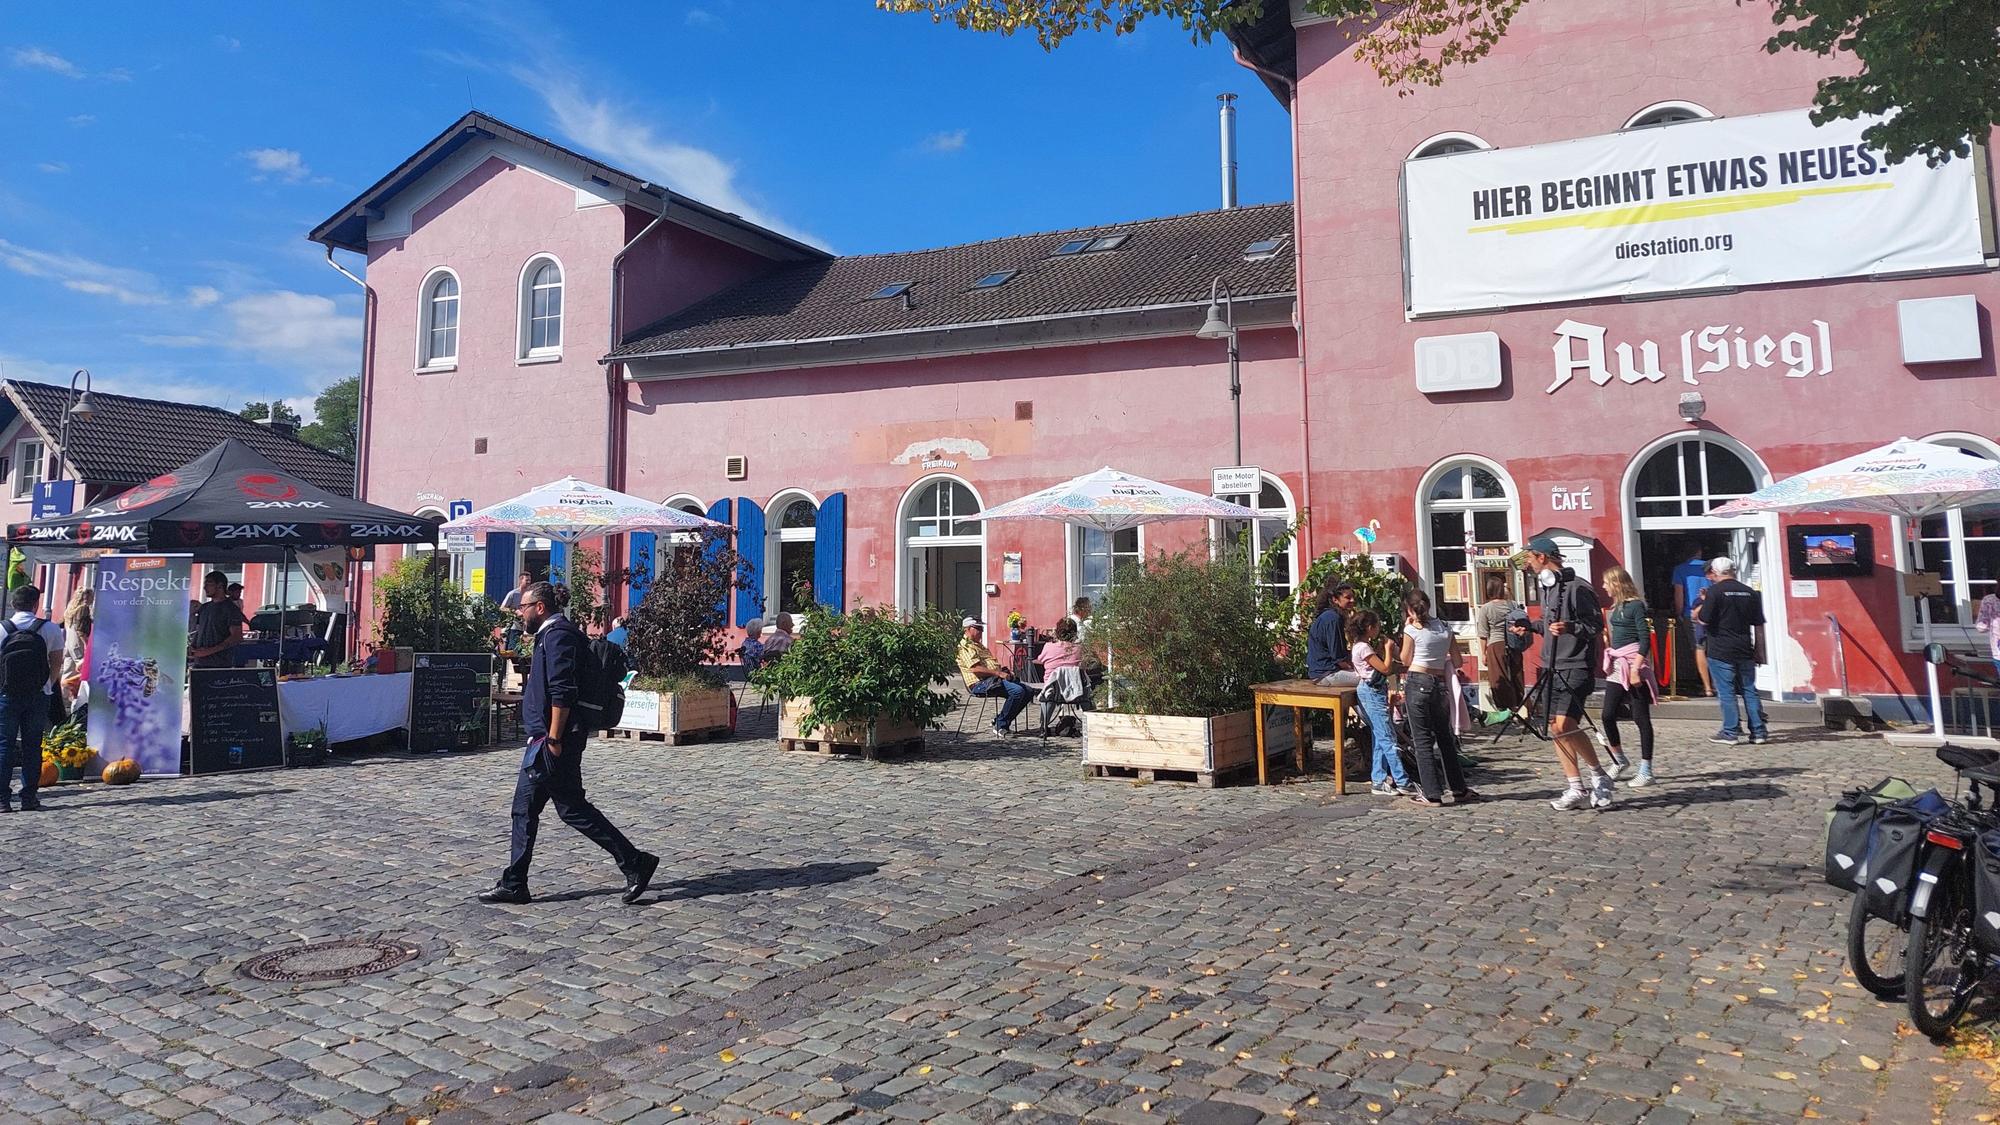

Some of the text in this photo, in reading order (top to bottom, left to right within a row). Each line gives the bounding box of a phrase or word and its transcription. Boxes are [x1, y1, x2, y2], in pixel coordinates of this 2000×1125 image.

[1472, 143, 1888, 220] HIER BEGINNT ETWAS NEUES.
[1615, 234, 1733, 259] diestation.org
[1545, 319, 1666, 394] Au
[921, 460, 958, 470] FREIRAUM
[44, 483, 52, 498] 11
[246, 501, 331, 509] 24MX
[1551, 486, 1593, 511] CAFÉ
[454, 505, 467, 520] P
[29, 525, 137, 541] 24MX 24MX
[214, 524, 424, 539] 24MX 24MX
[130, 560, 160, 568] demeter
[100, 569, 191, 597] Respekt
[146, 597, 174, 605] Natur
[625, 700, 658, 711] kerseifer
